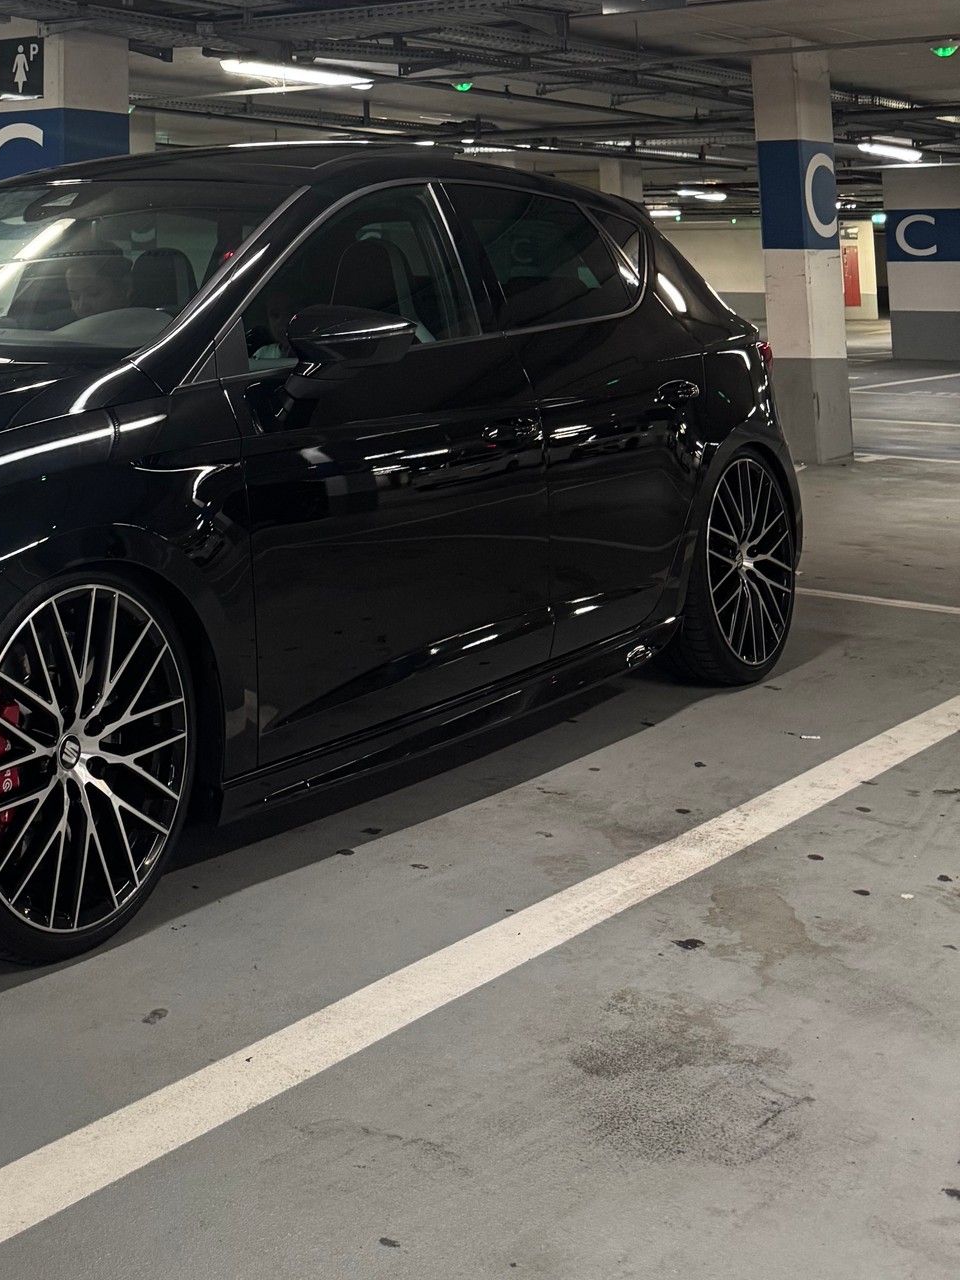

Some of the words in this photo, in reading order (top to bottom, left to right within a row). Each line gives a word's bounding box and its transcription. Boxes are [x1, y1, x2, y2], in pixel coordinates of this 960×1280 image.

[29, 43, 39, 62] P
[804, 153, 838, 238] C
[895, 214, 937, 256] C
